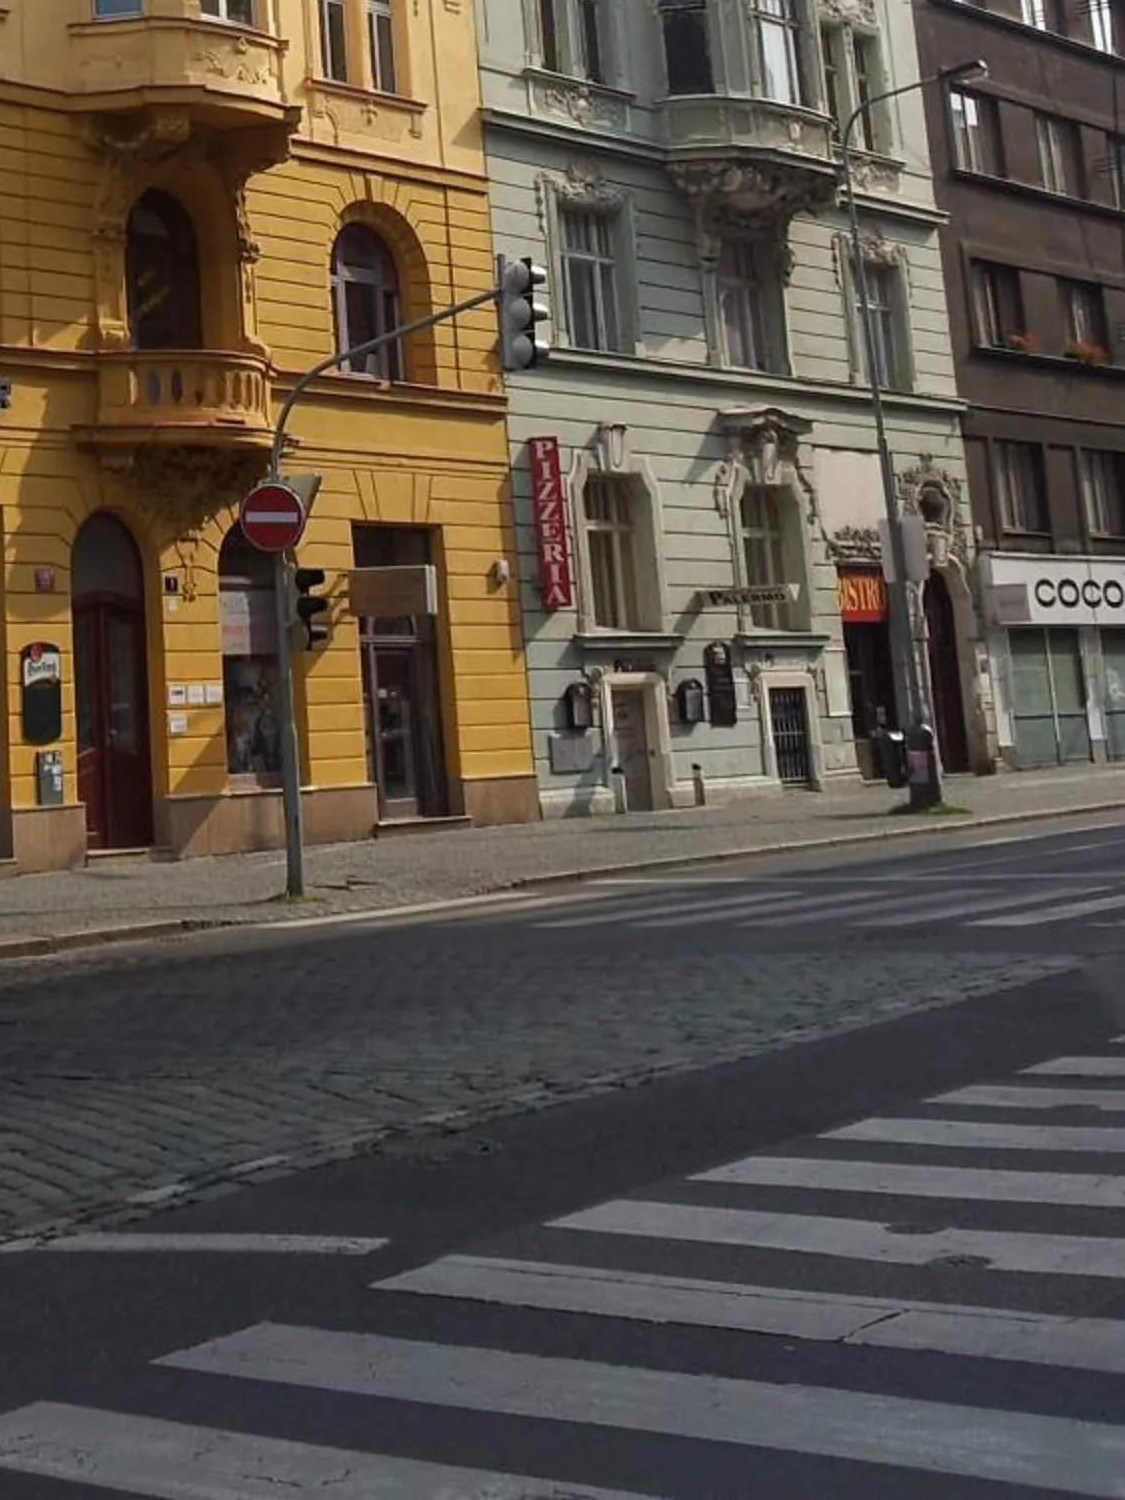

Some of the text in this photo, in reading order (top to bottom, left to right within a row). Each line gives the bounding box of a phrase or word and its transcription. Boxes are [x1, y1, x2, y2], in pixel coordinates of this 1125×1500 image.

[536, 440, 568, 606] PIZZERIA
[836, 574, 888, 612] BISTRO
[1034, 577, 1125, 609] COCO
